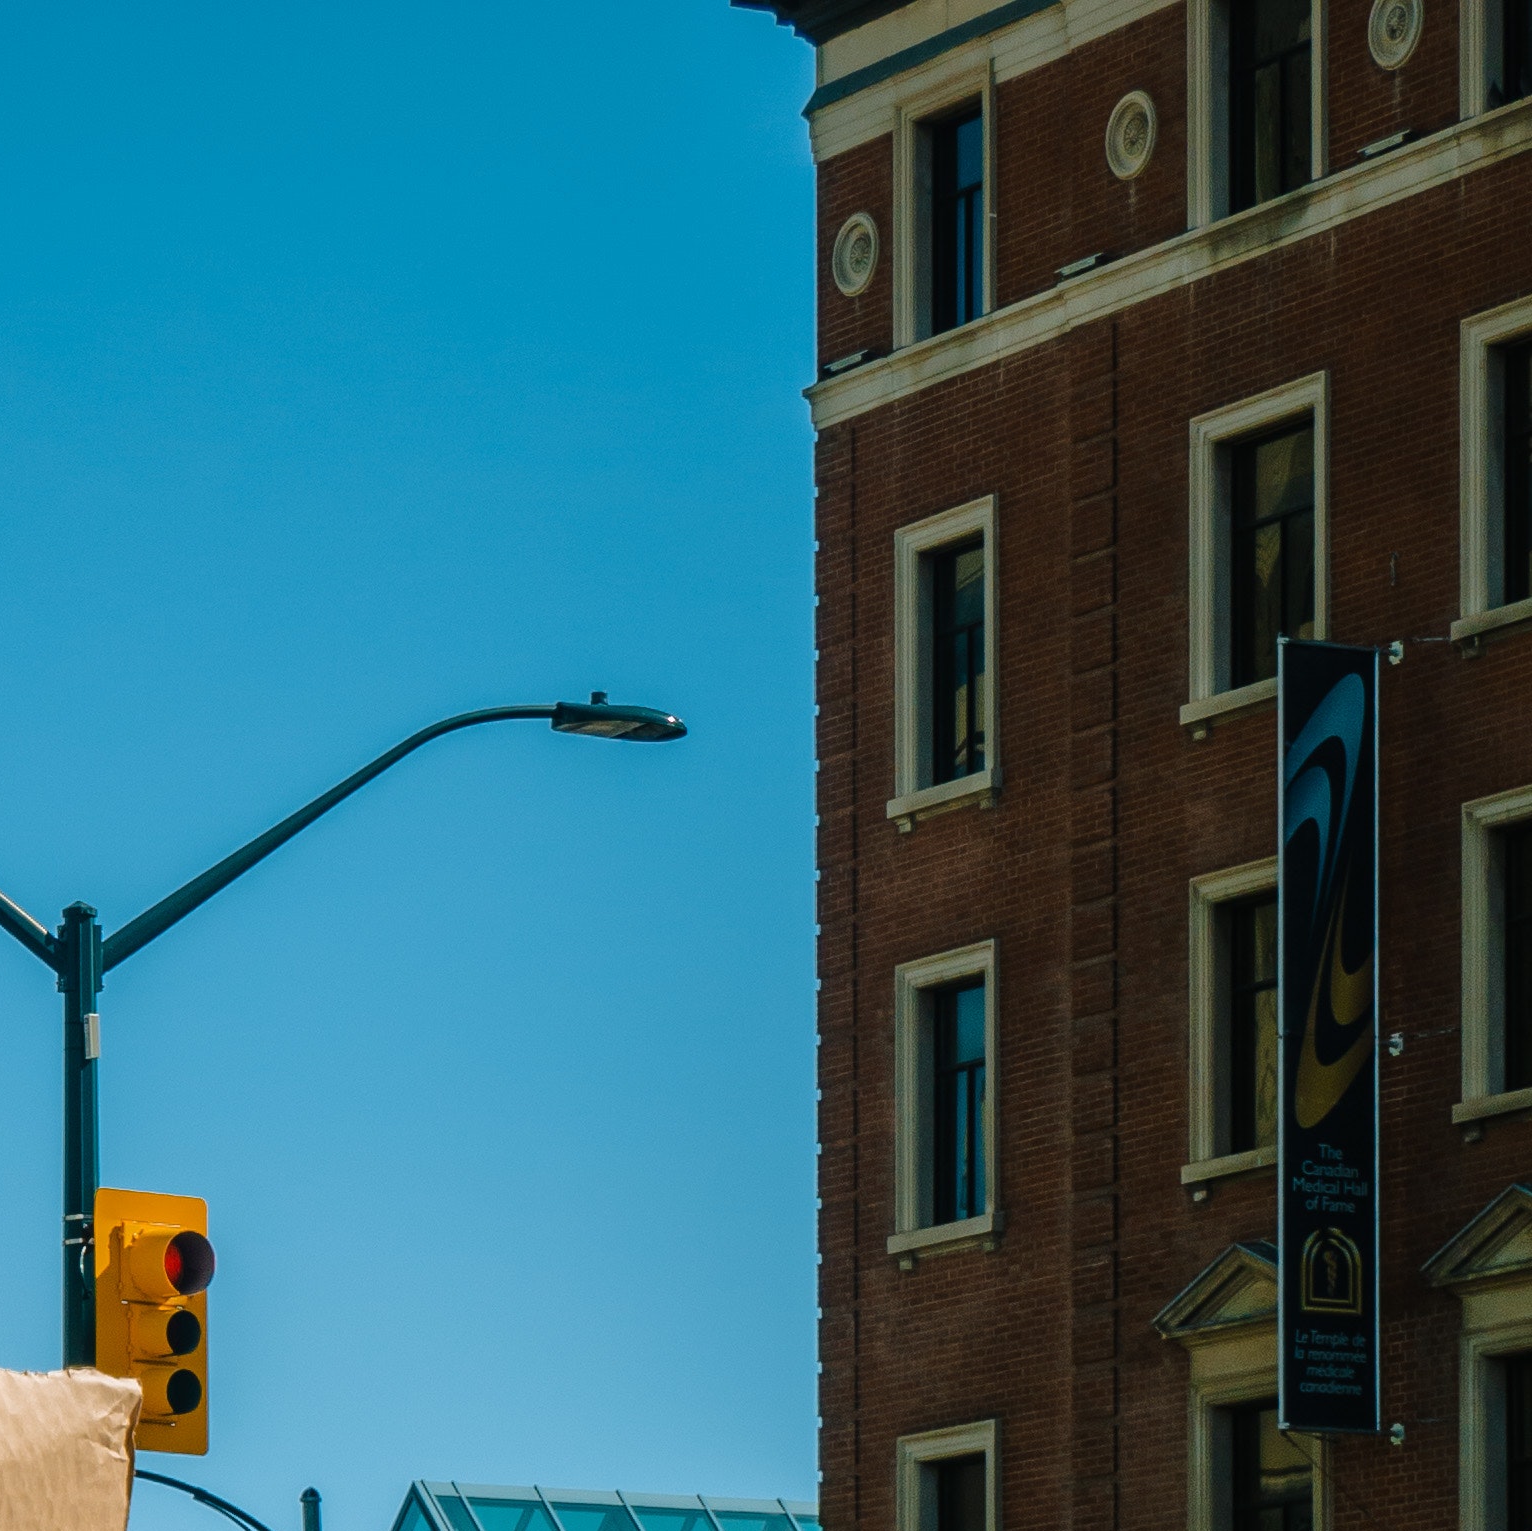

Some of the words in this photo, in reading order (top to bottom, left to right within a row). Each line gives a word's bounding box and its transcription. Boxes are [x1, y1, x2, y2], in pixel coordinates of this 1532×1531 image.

[1318, 1143, 1343, 1160] The
[1301, 1160, 1359, 1179] Canadian
[1292, 1177, 1340, 1194] Medical
[1343, 1181, 1368, 1197] Hall
[1305, 1196, 1319, 1212] of
[1322, 1198, 1356, 1213] Fame
